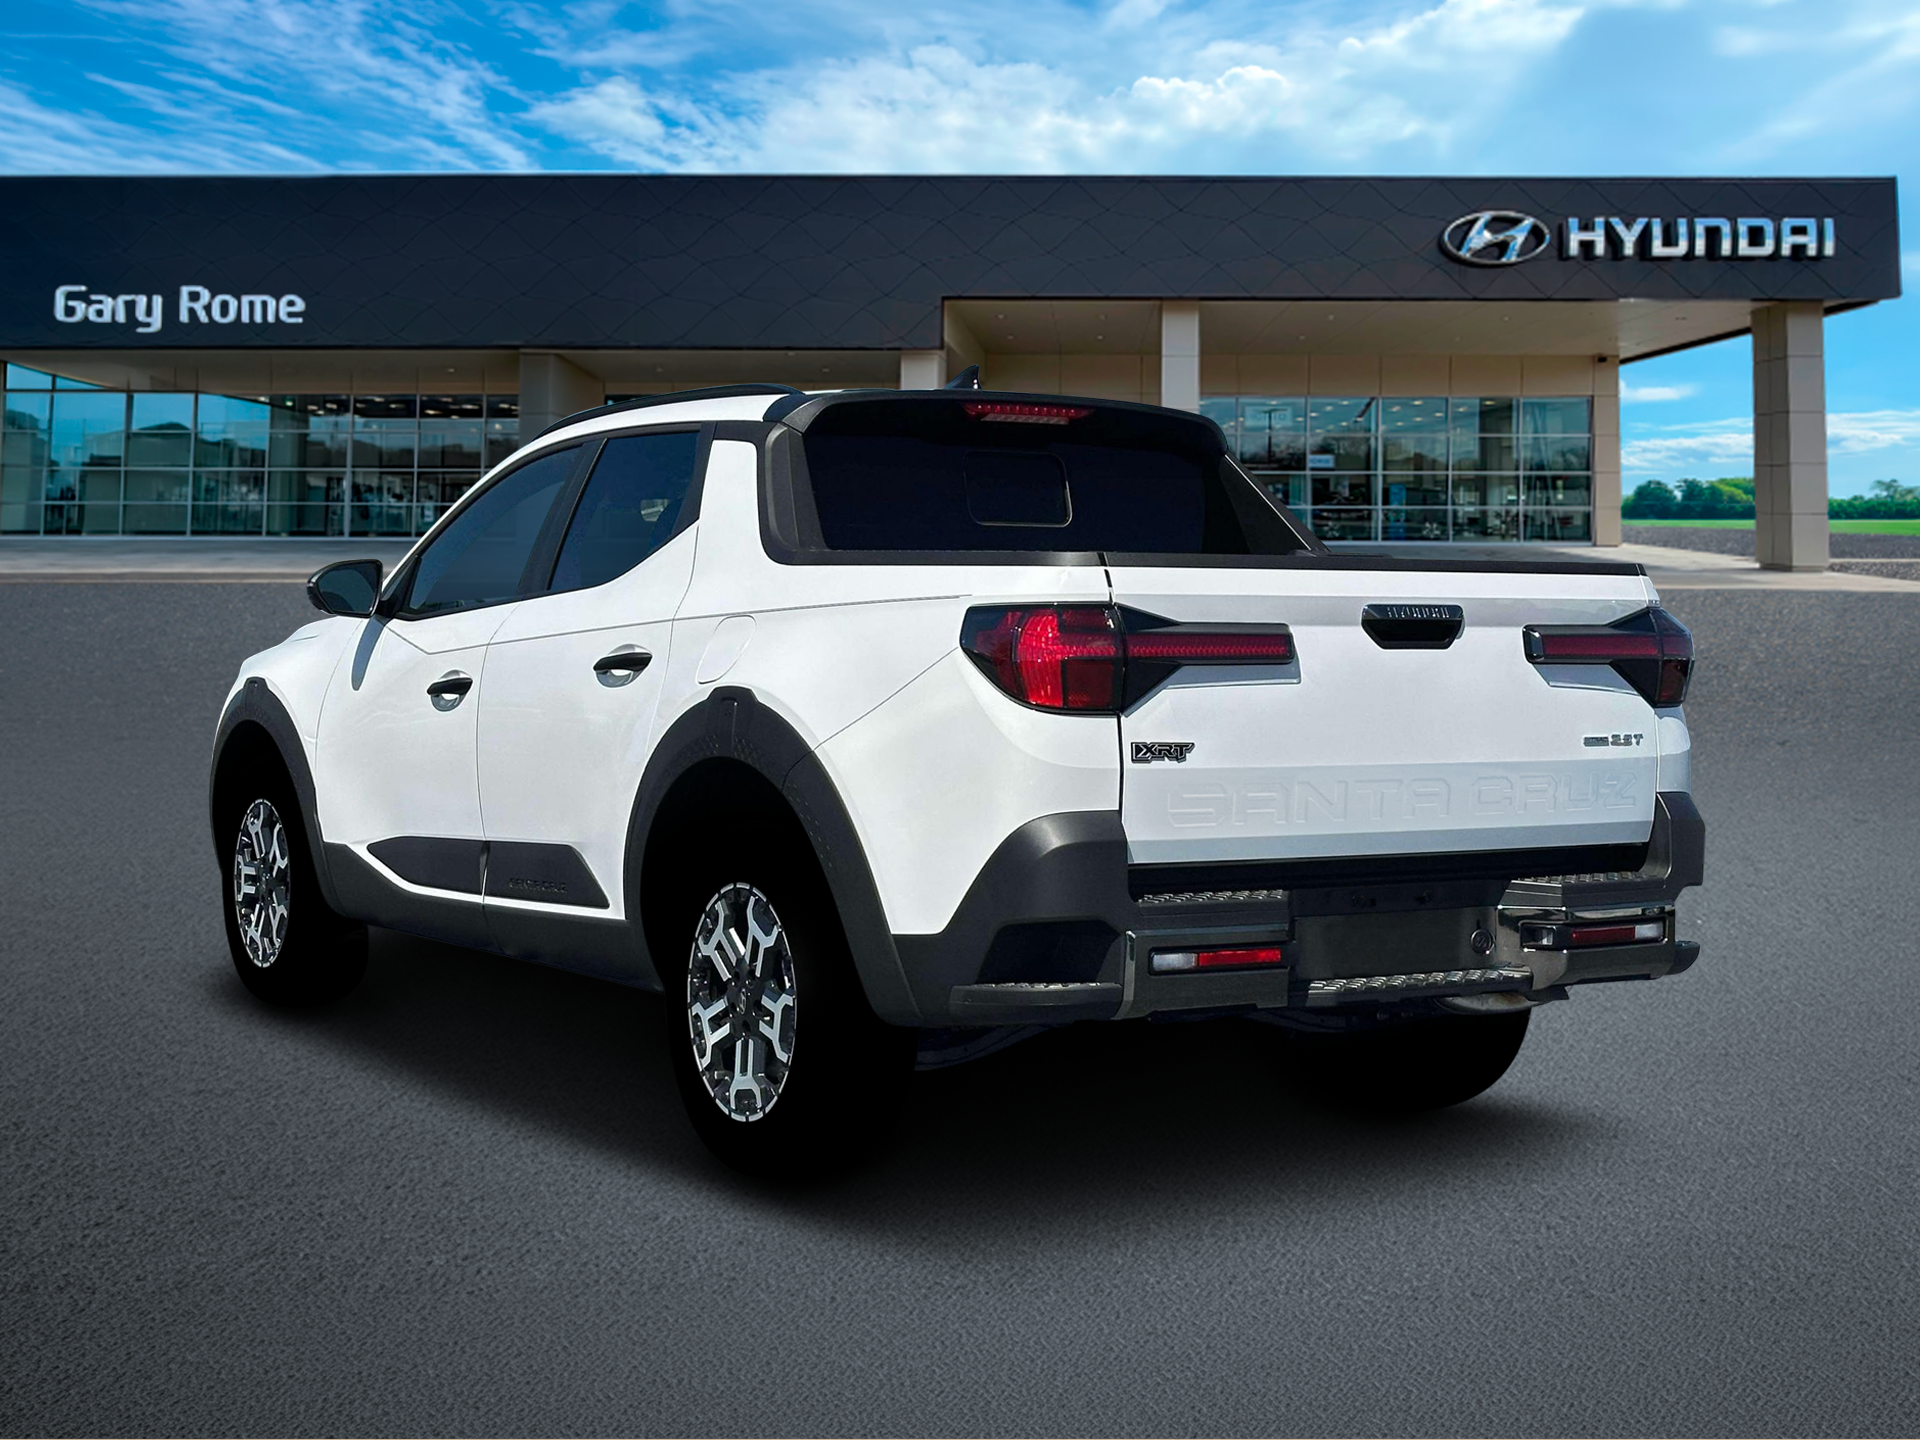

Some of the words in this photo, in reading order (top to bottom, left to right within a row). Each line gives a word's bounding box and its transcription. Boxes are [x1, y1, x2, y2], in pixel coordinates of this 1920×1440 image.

[1567, 216, 1834, 258] HYUNDAI
[53, 284, 163, 333] Gary
[178, 284, 306, 324] Rome
[1131, 741, 1195, 763] XRT
[1166, 778, 1452, 828] SANTA
[1472, 769, 1639, 817] CRUZ
